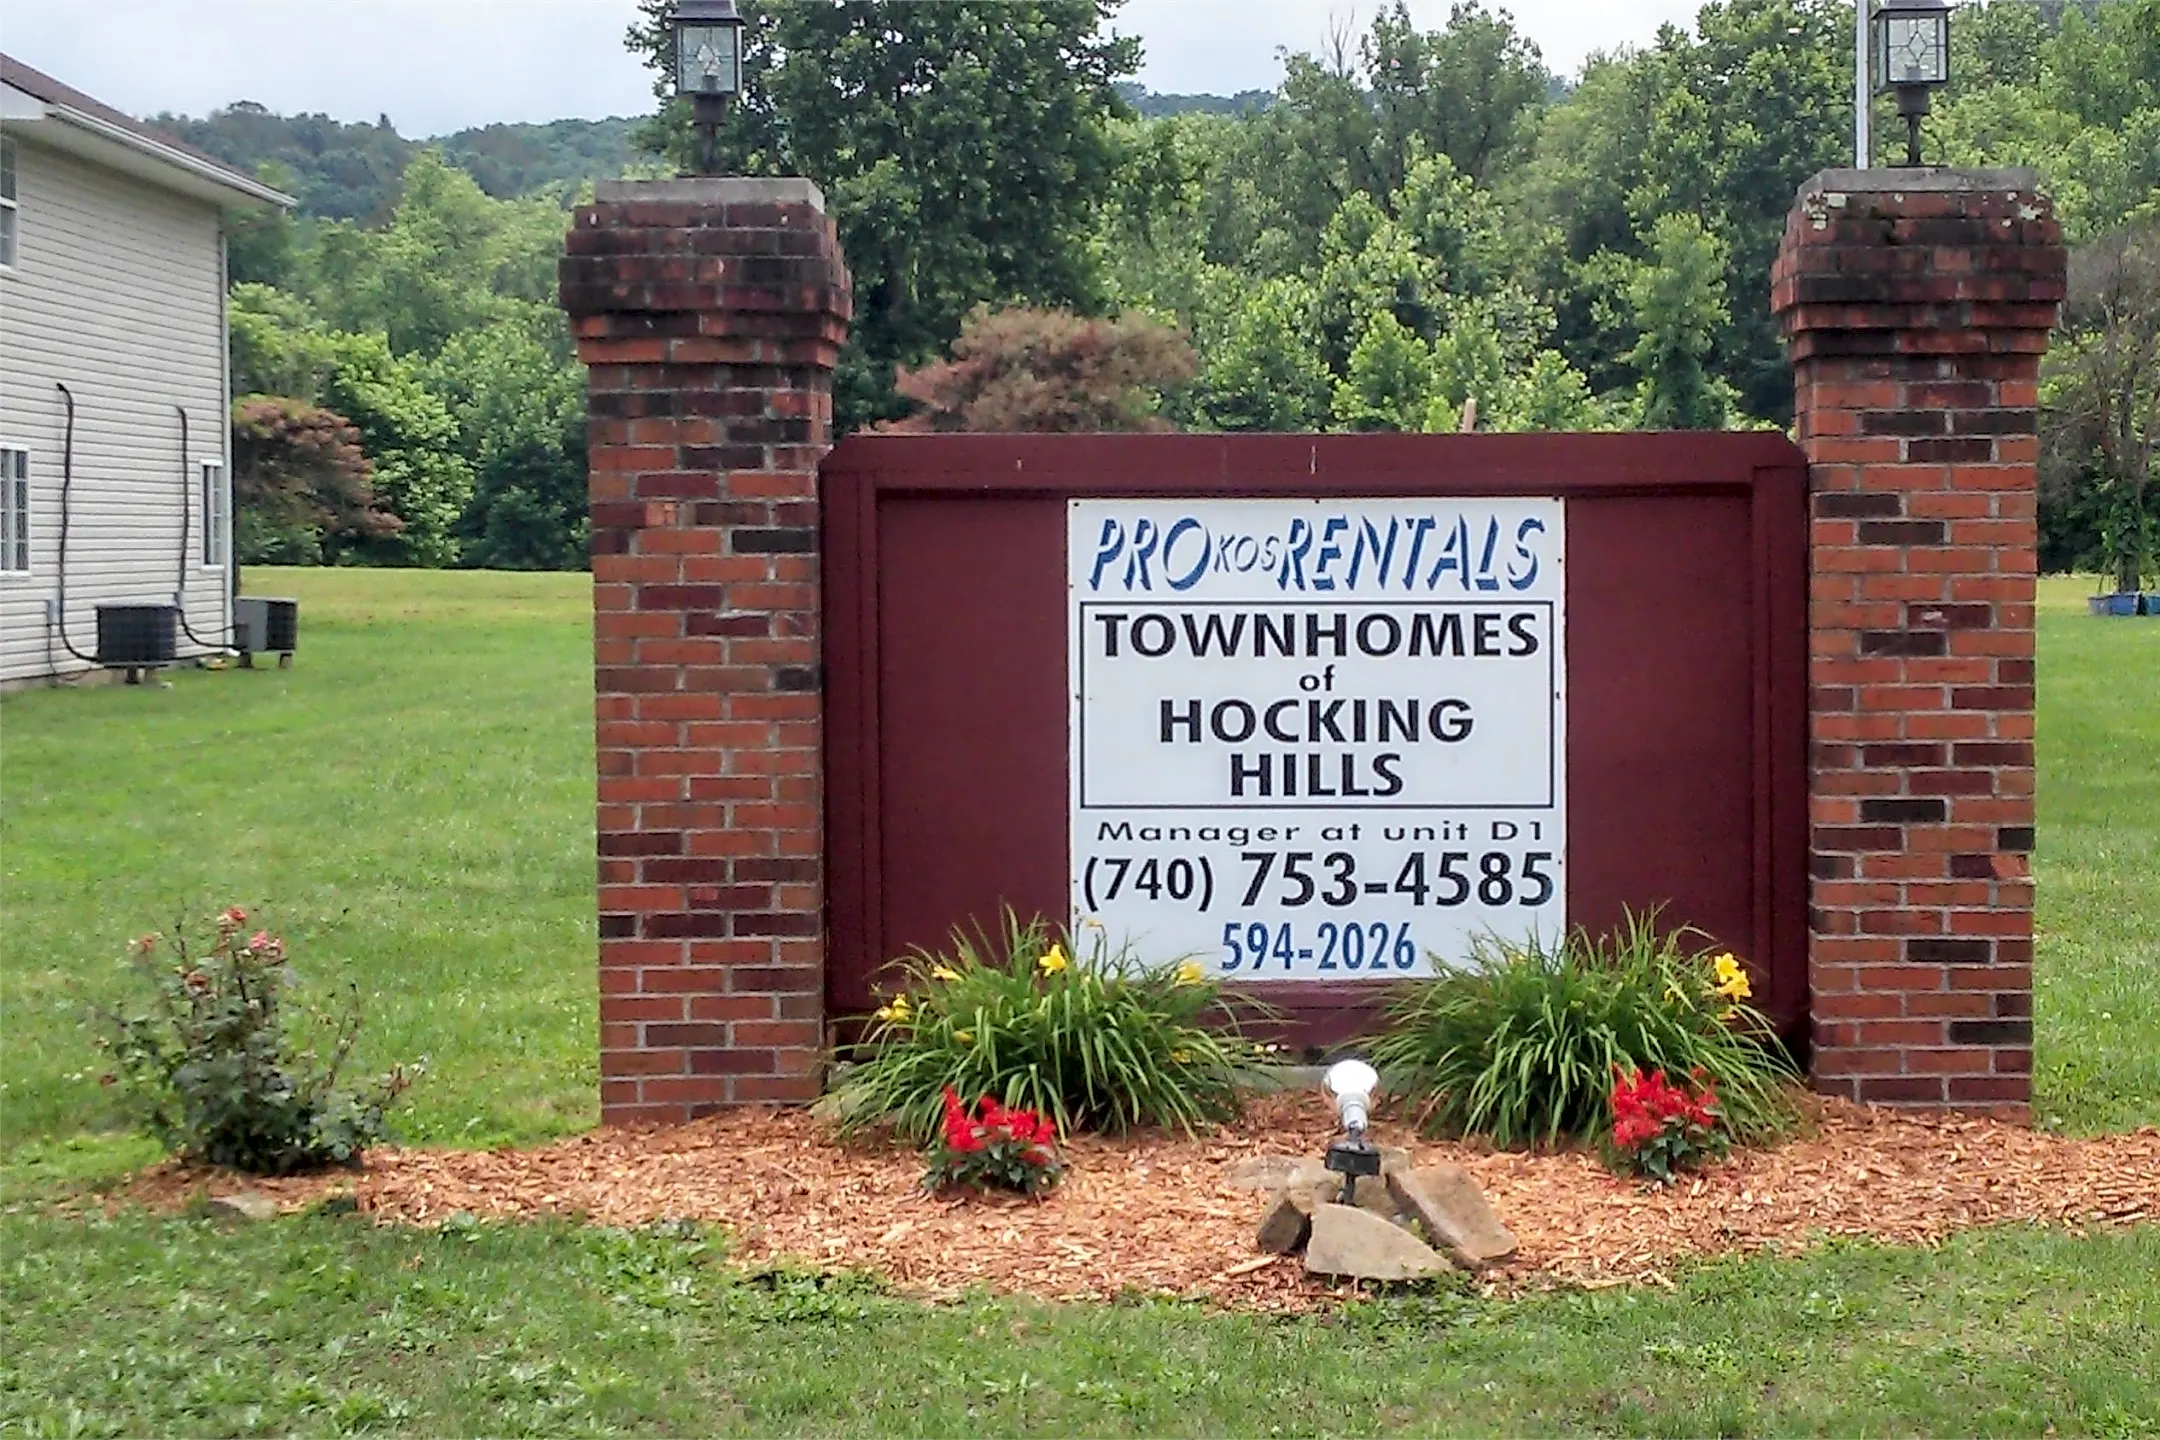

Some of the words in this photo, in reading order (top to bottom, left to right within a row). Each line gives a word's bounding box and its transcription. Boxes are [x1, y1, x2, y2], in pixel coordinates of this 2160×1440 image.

[1095, 613, 1540, 657] TOWNHOMES
[1299, 665, 1335, 692] of
[1159, 698, 1474, 743] HOCKING
[1230, 753, 1404, 797] HILLS
[1097, 821, 1300, 846] Manager
[1321, 822, 1362, 841] at
[1383, 820, 1469, 841] unit
[1491, 821, 1543, 841] D1
[1083, 856, 1213, 912] (740)
[1241, 851, 1553, 907] 753-4585
[1221, 922, 1416, 970] 594-2026
